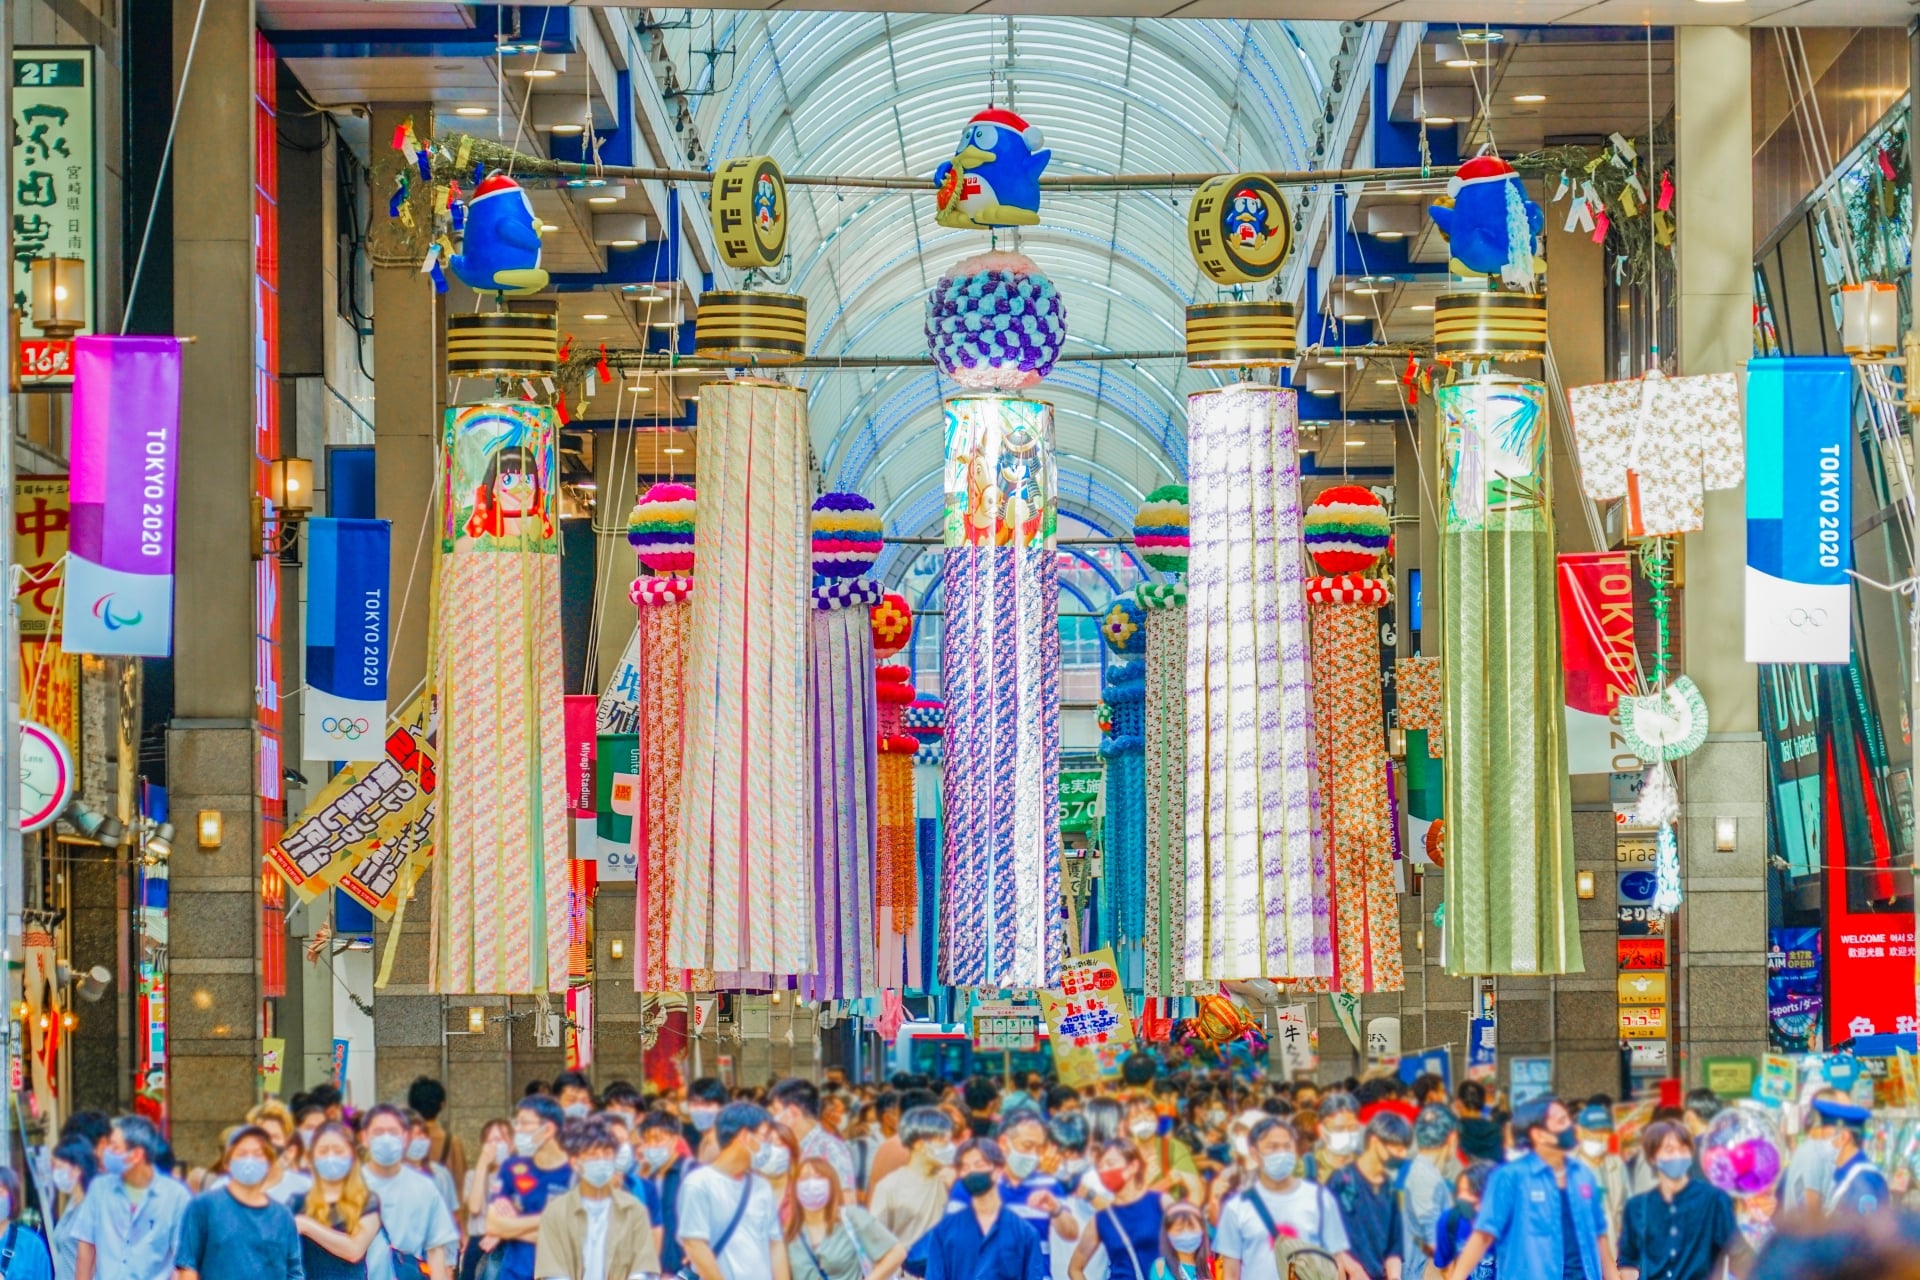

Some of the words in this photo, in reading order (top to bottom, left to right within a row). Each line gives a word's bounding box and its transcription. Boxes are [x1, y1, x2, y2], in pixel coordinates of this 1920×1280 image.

[21, 63, 59, 85] 2F
[144, 428, 166, 499] TOKYO
[1819, 444, 1840, 513] TOKYO
[141, 503, 163, 556] 2020
[1819, 517, 1840, 568] 2020
[365, 588, 380, 643] TOKYO
[1599, 553, 1635, 674] TOKYO
[363, 646, 379, 686] 2020
[580, 742, 591, 771] Miyagi
[580, 773, 591, 809] Stadium
[1841, 933, 1887, 945] WELCOME
[1906, 931, 1916, 943] 오
